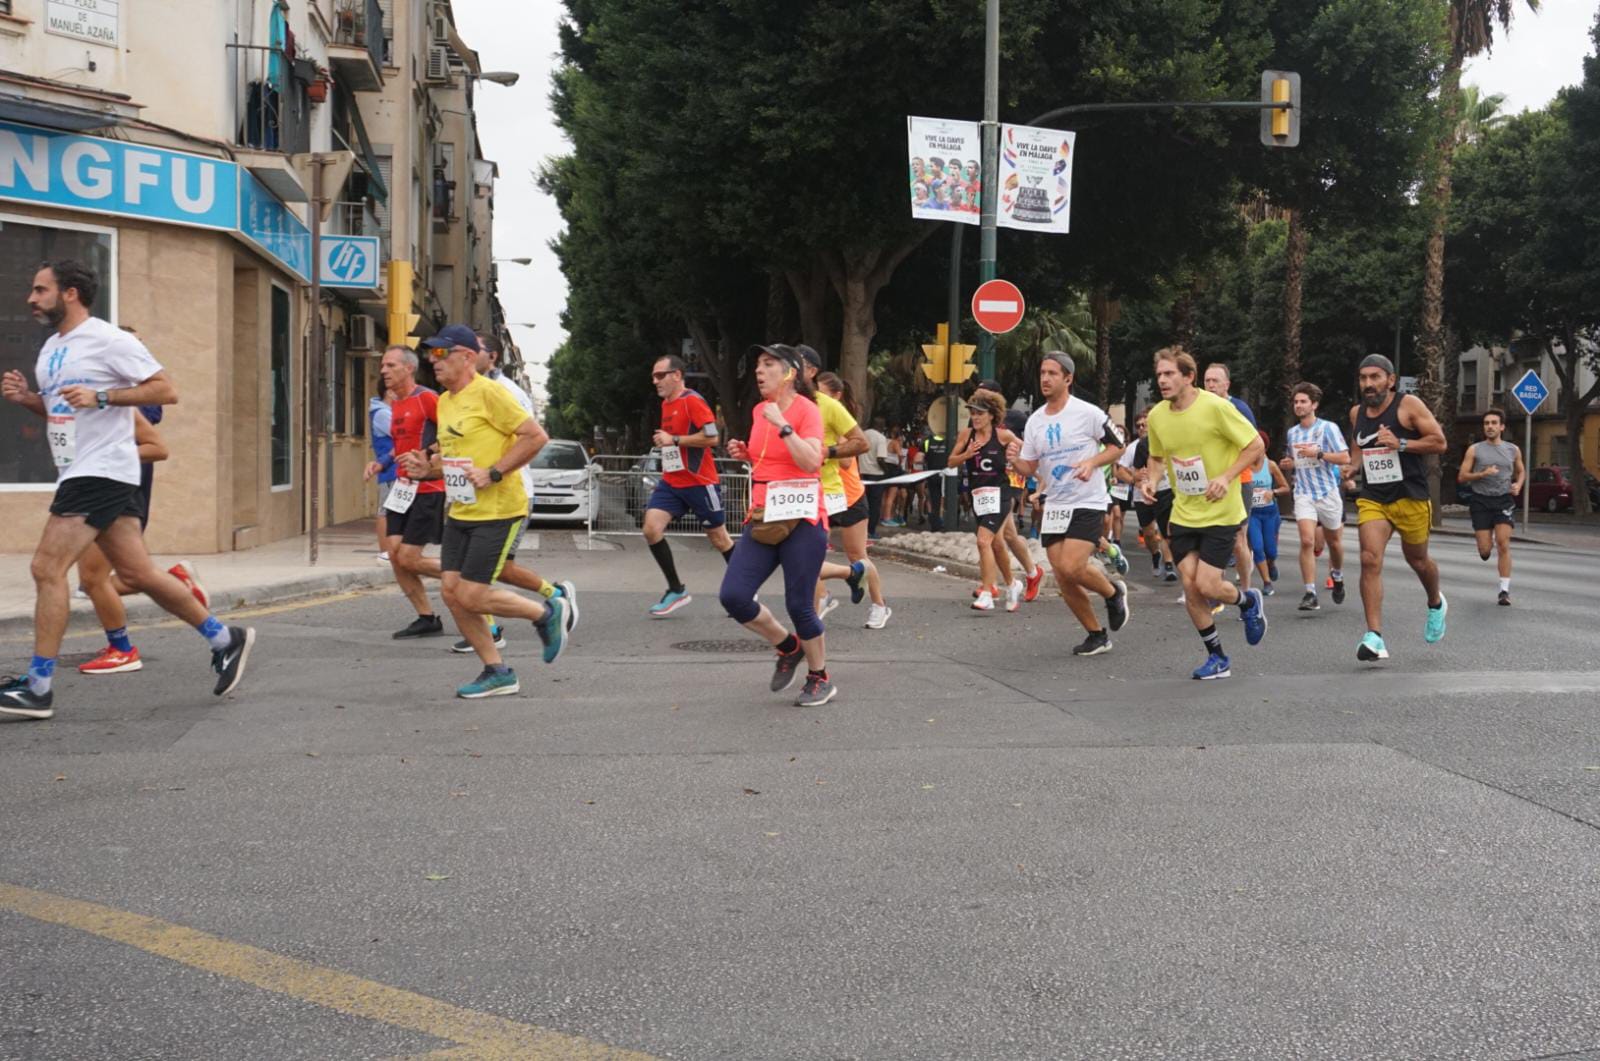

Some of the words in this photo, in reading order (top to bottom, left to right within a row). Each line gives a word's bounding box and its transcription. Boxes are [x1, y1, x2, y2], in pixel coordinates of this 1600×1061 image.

[78, 12, 87, 22] DE
[50, 17, 85, 35] MANUEL
[87, 26, 114, 41] AZAÑA
[1016, 142, 1029, 150] VIVE
[0, 130, 215, 214] NGFU
[1369, 459, 1394, 470] 6258
[770, 494, 815, 506] 13005
[1046, 510, 1071, 521] 13154
